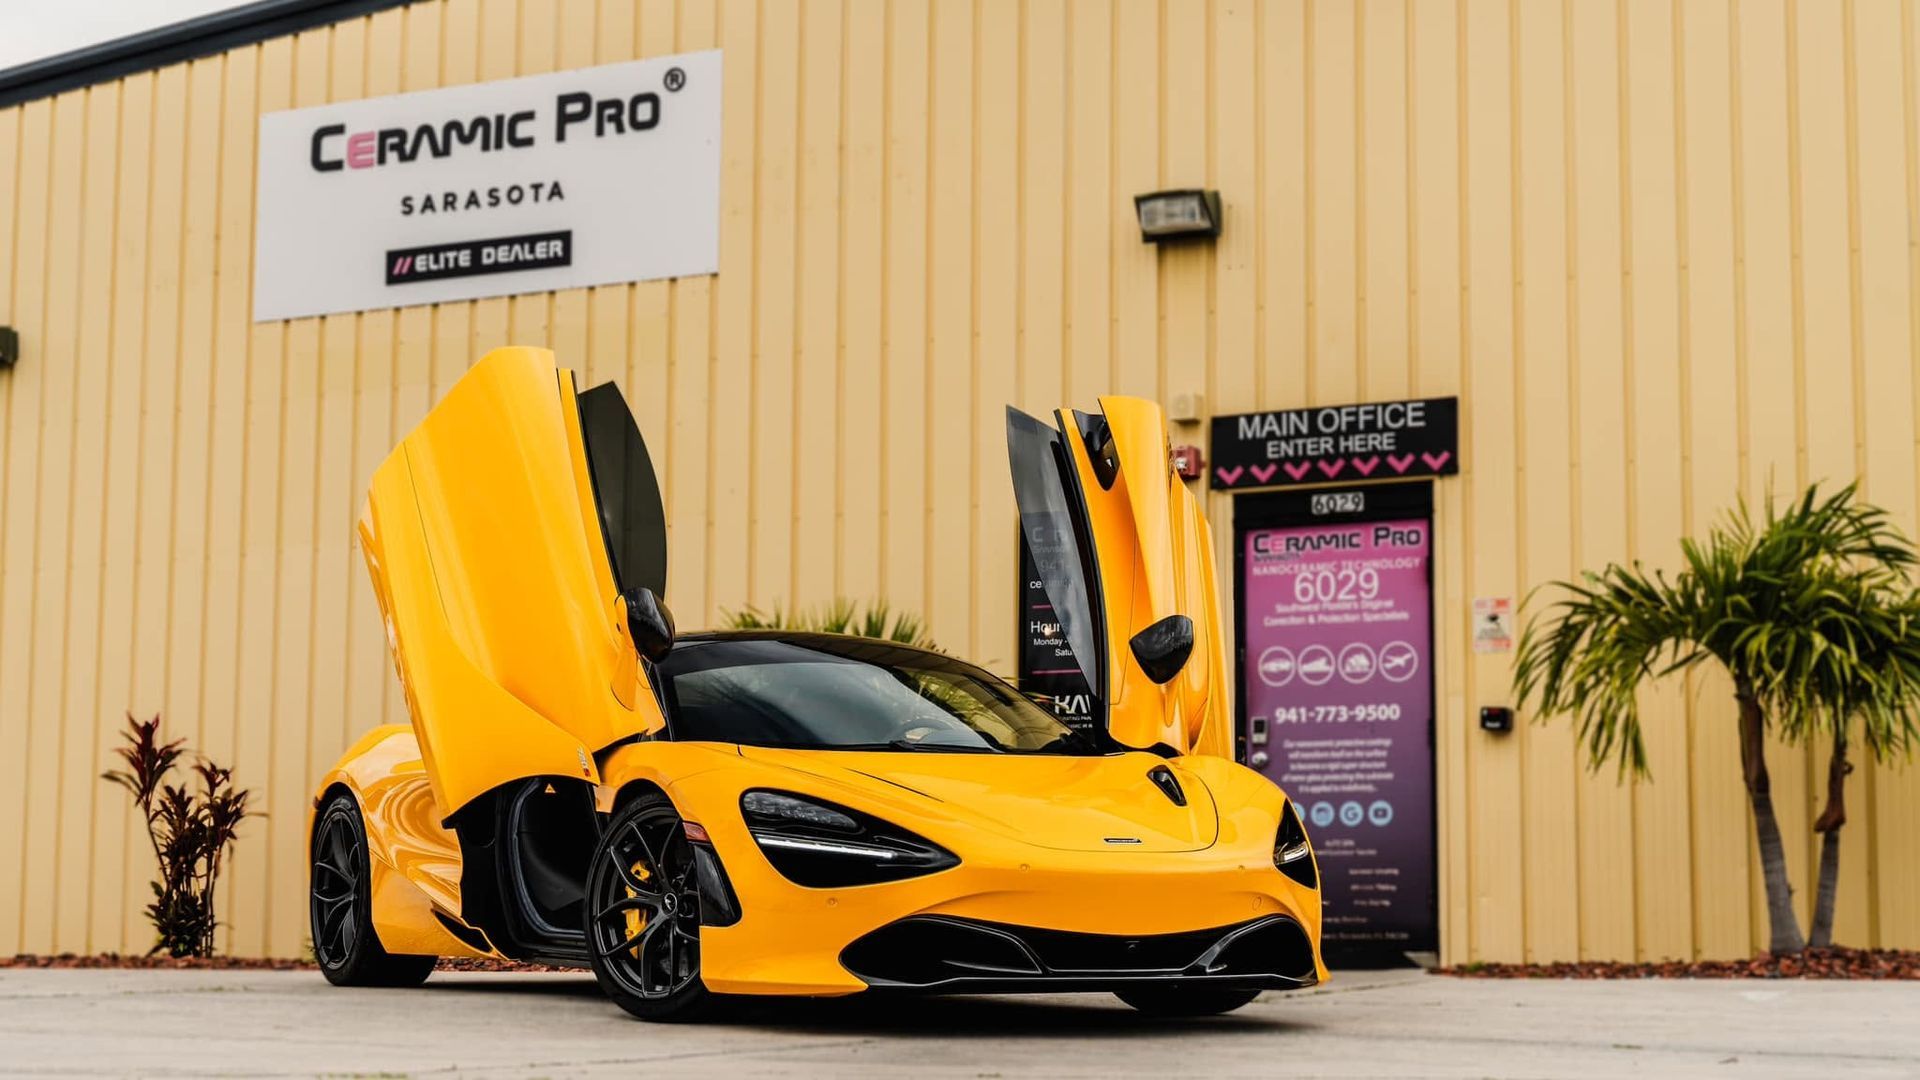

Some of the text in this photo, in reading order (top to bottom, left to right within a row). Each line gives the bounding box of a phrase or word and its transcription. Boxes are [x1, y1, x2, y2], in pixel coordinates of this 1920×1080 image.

[311, 110, 535, 172] CERAMIC
[401, 180, 565, 215] SARASOTA
[481, 240, 564, 265] DEALER
[1238, 402, 1426, 440] MAIN OFFICE
[1266, 432, 1396, 459] ENTER HERE
[1313, 493, 1362, 514] 6029
[1341, 557, 1421, 573] TECHNOLOGY
[1294, 568, 1380, 602] 6029
[1033, 638, 1063, 647] Monday
[1055, 648, 1073, 657] Satu
[1275, 704, 1401, 724] 941-773-9500
